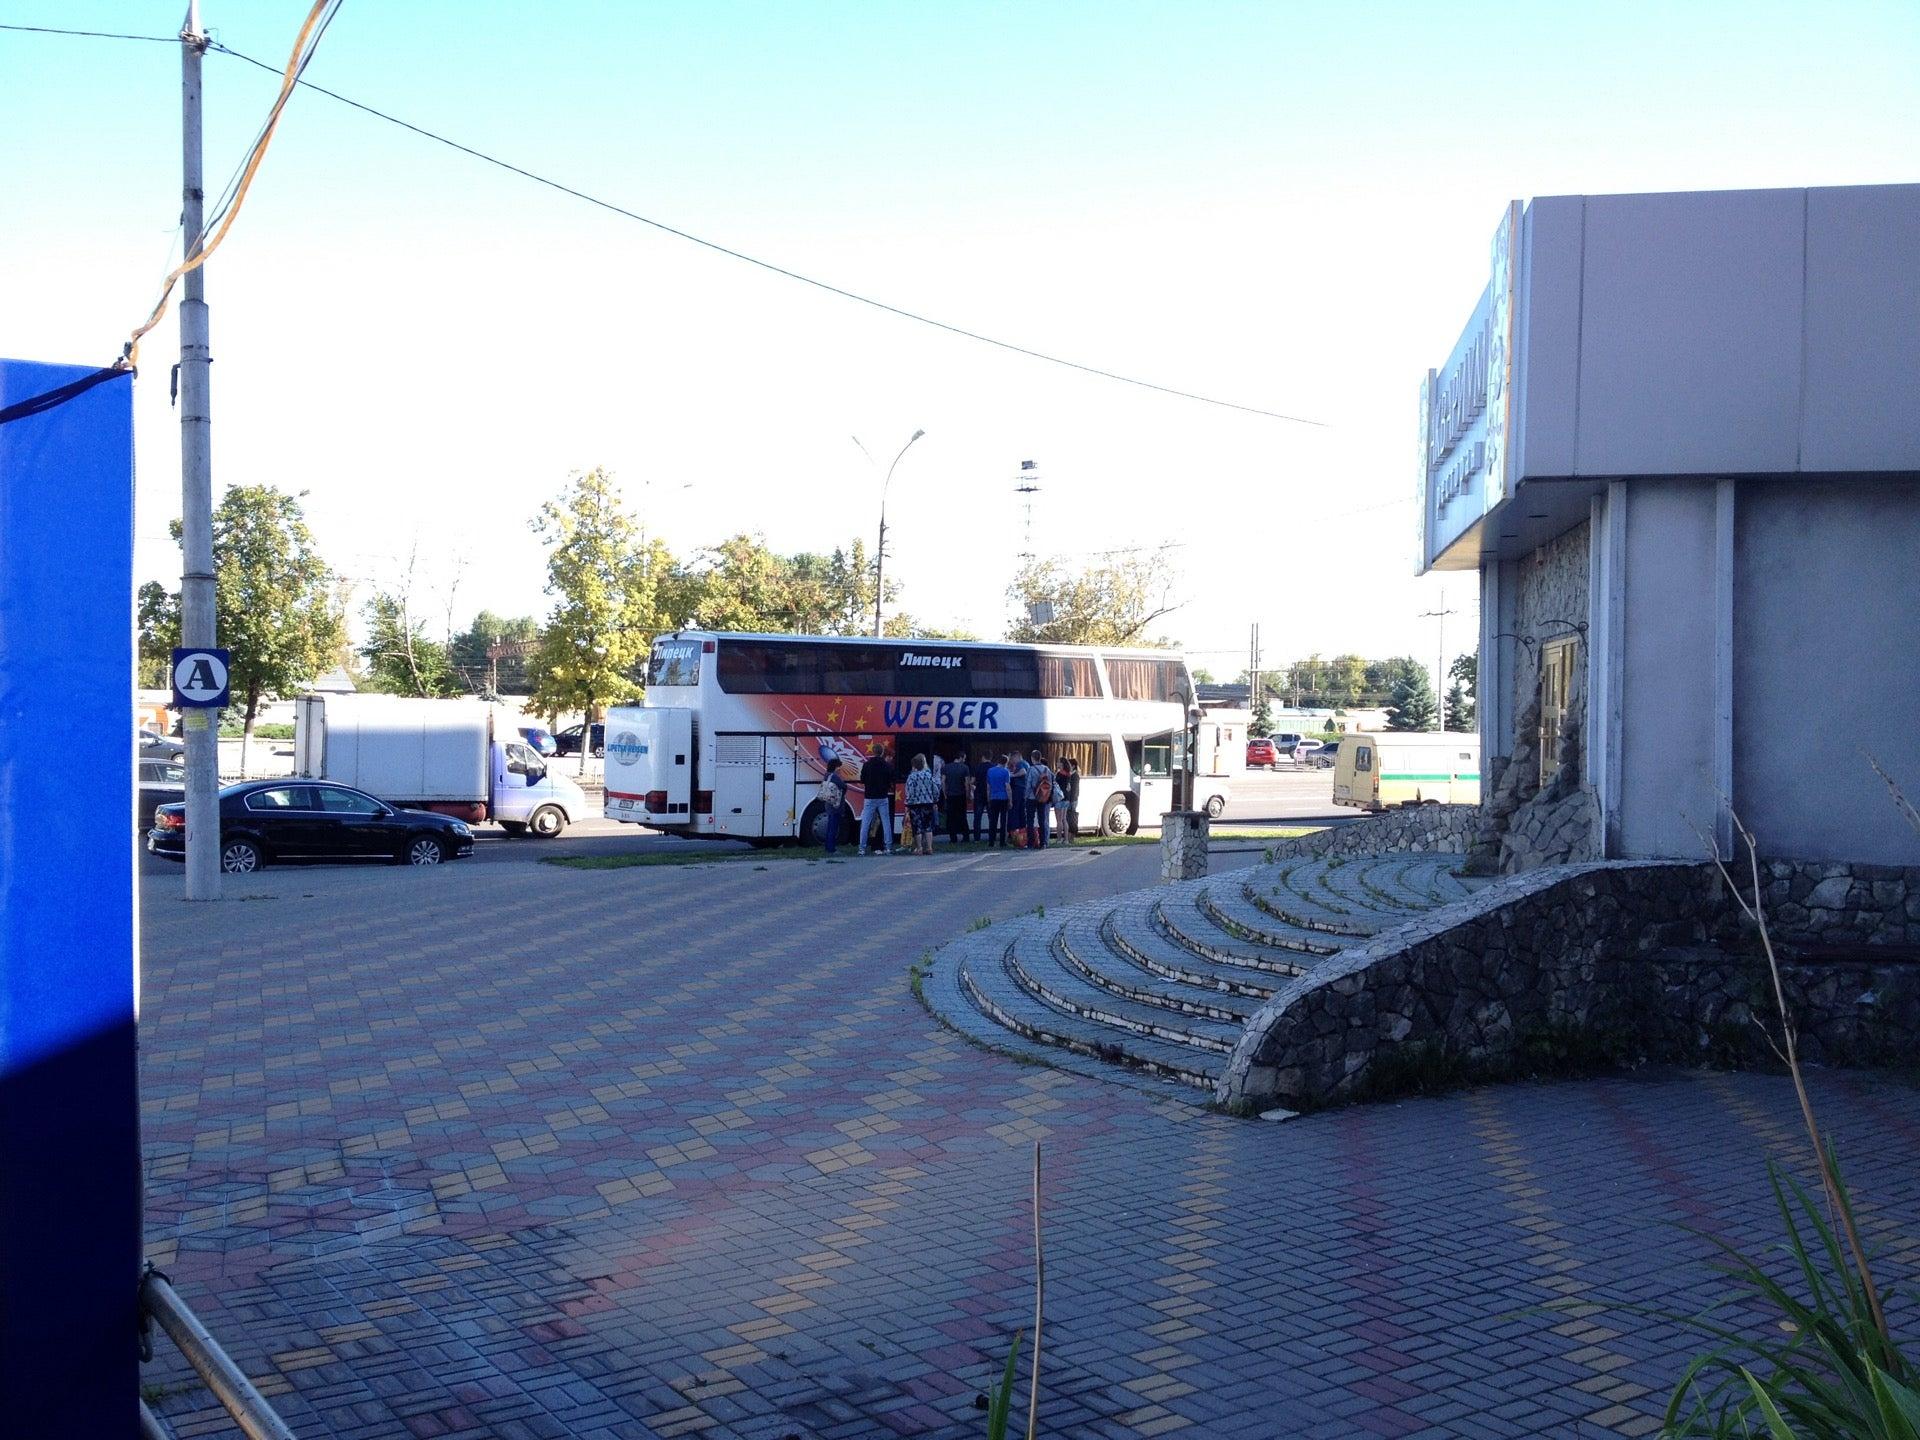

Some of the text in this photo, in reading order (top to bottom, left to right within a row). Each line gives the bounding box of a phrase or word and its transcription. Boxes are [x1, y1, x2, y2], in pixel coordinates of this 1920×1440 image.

[654, 645, 694, 660] Липецк
[900, 653, 963, 669] Липецк
[884, 700, 999, 729] WEBER
